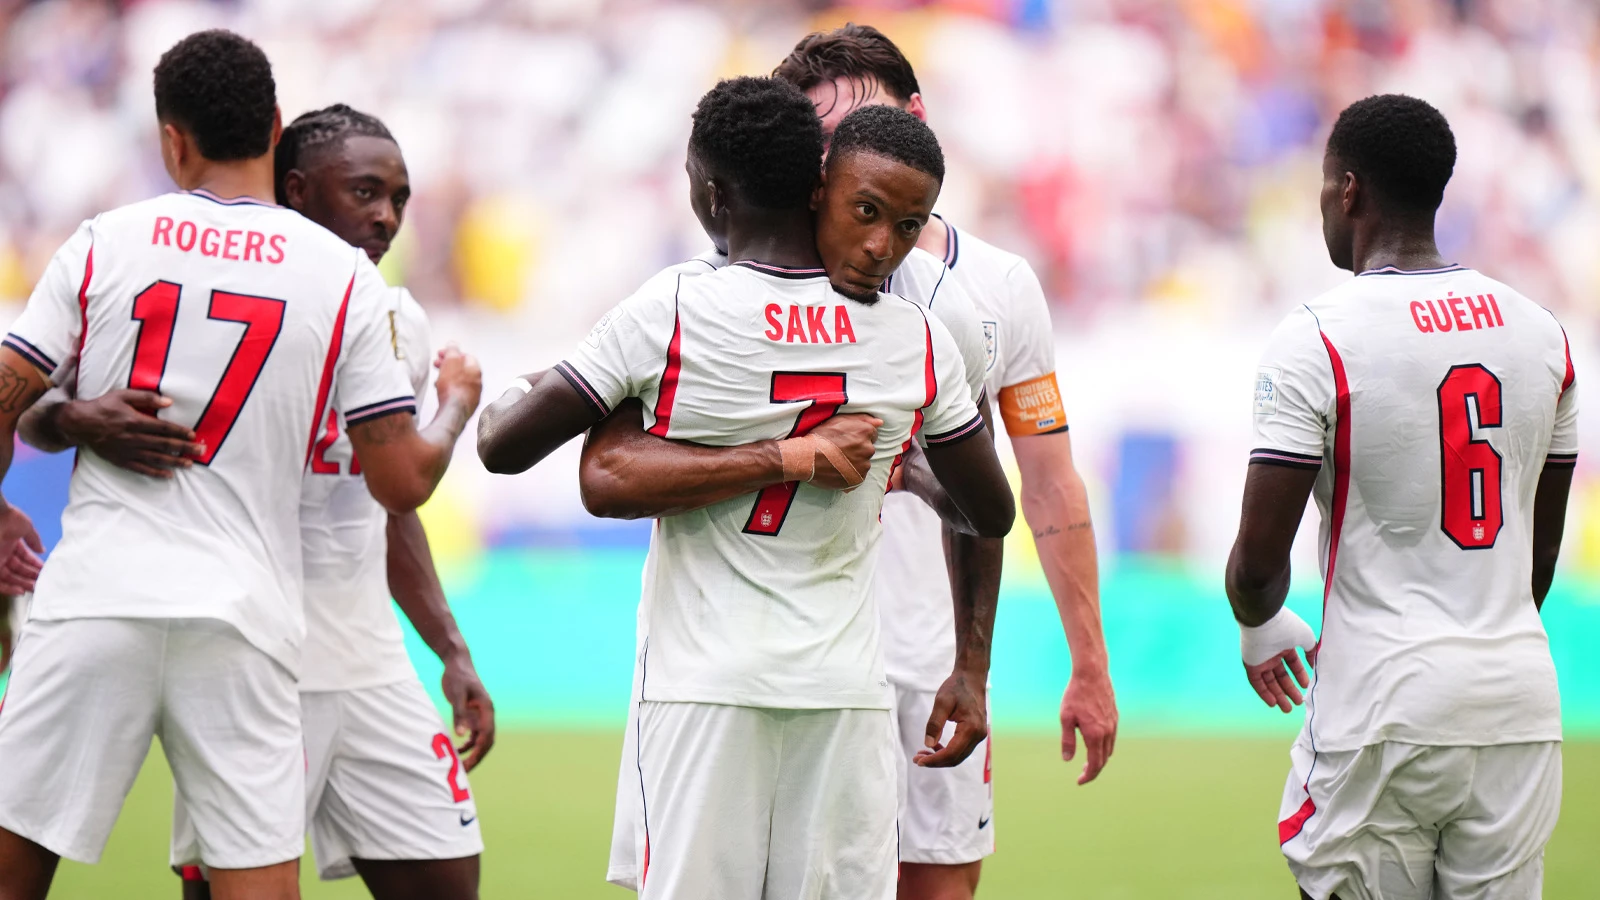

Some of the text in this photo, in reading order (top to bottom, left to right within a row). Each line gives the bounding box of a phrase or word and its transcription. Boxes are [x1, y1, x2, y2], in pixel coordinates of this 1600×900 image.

[152, 217, 287, 264] ROGERS
[764, 303, 856, 344] SAKA
[1409, 292, 1505, 334] GUÉHI
[128, 279, 287, 466] 17
[1017, 388, 1058, 410] UNITES
[742, 371, 848, 536] 7
[1437, 363, 1504, 551] 6
